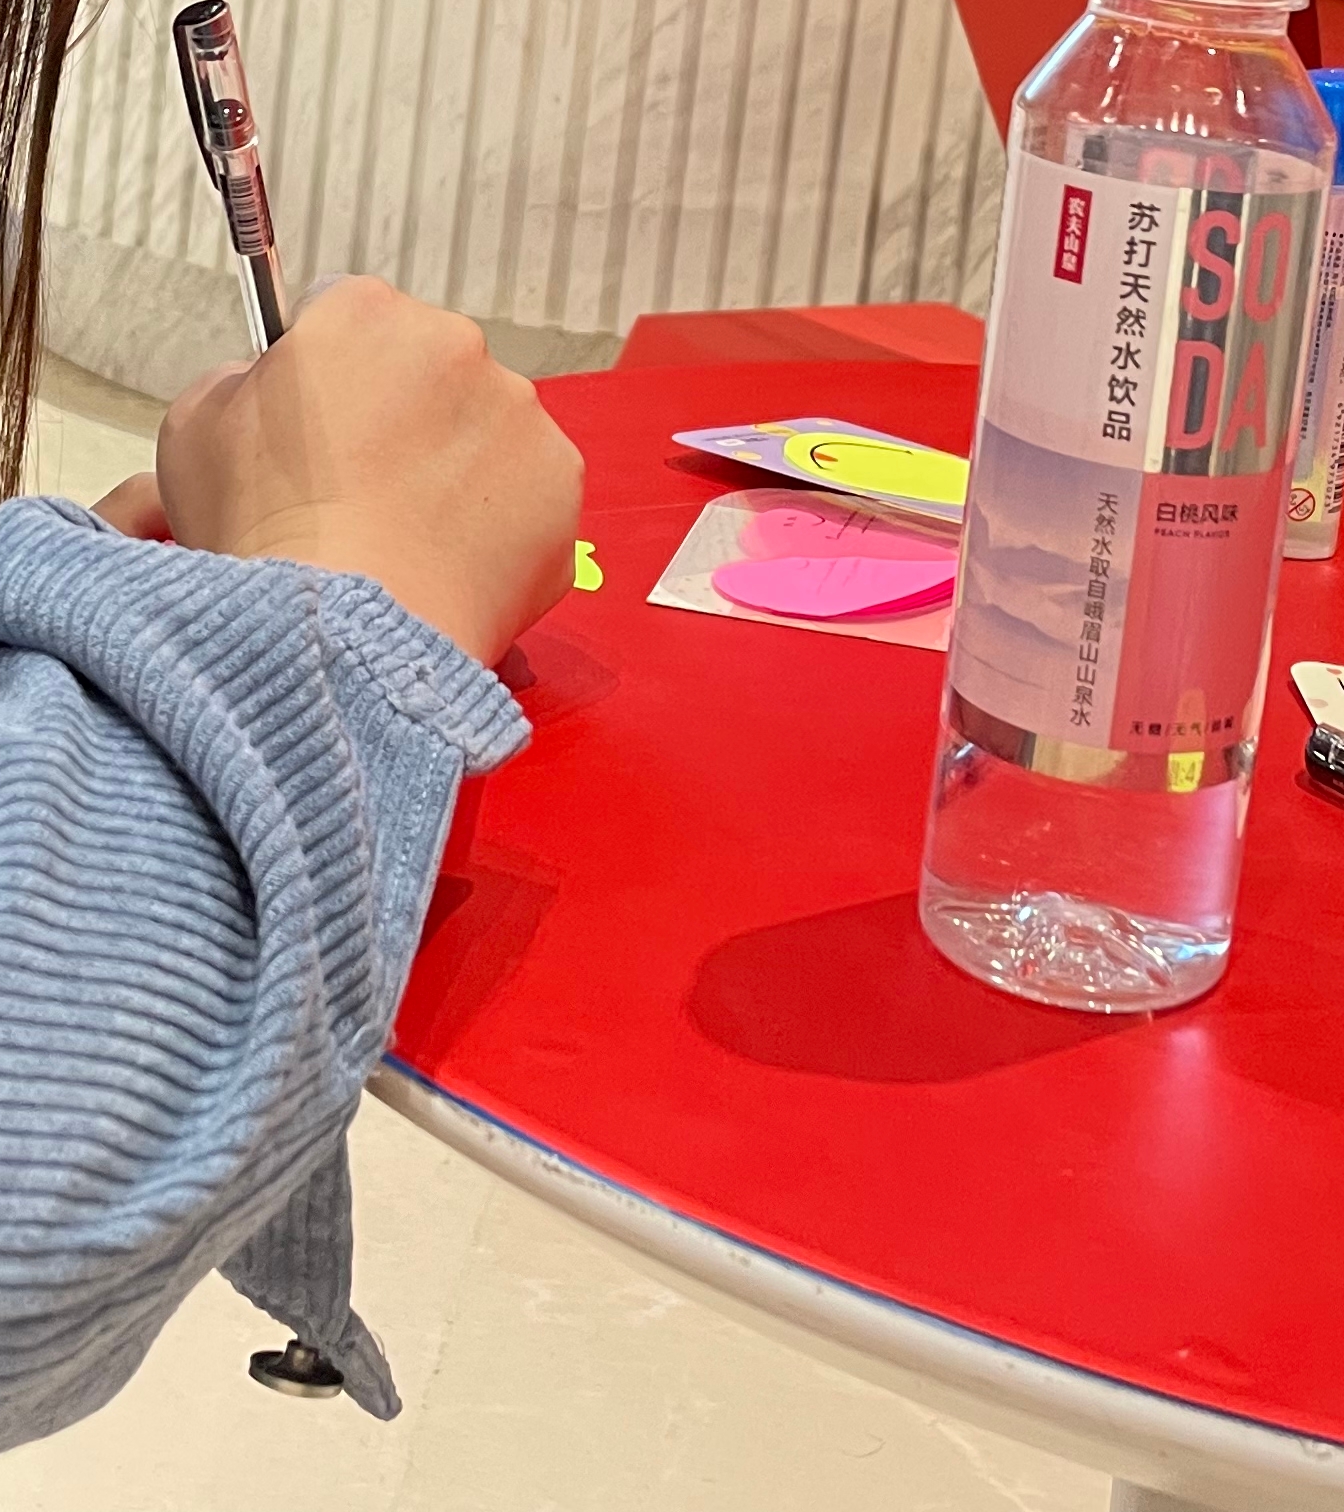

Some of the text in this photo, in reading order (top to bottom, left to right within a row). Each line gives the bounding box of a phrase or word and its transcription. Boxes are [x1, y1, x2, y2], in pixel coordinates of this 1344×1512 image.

[1102, 201, 1162, 442] 苏打天然水饮品
[1069, 491, 1120, 728] 天然水取自峨眉山山泉水
[1156, 501, 1239, 524] 白桃风味
